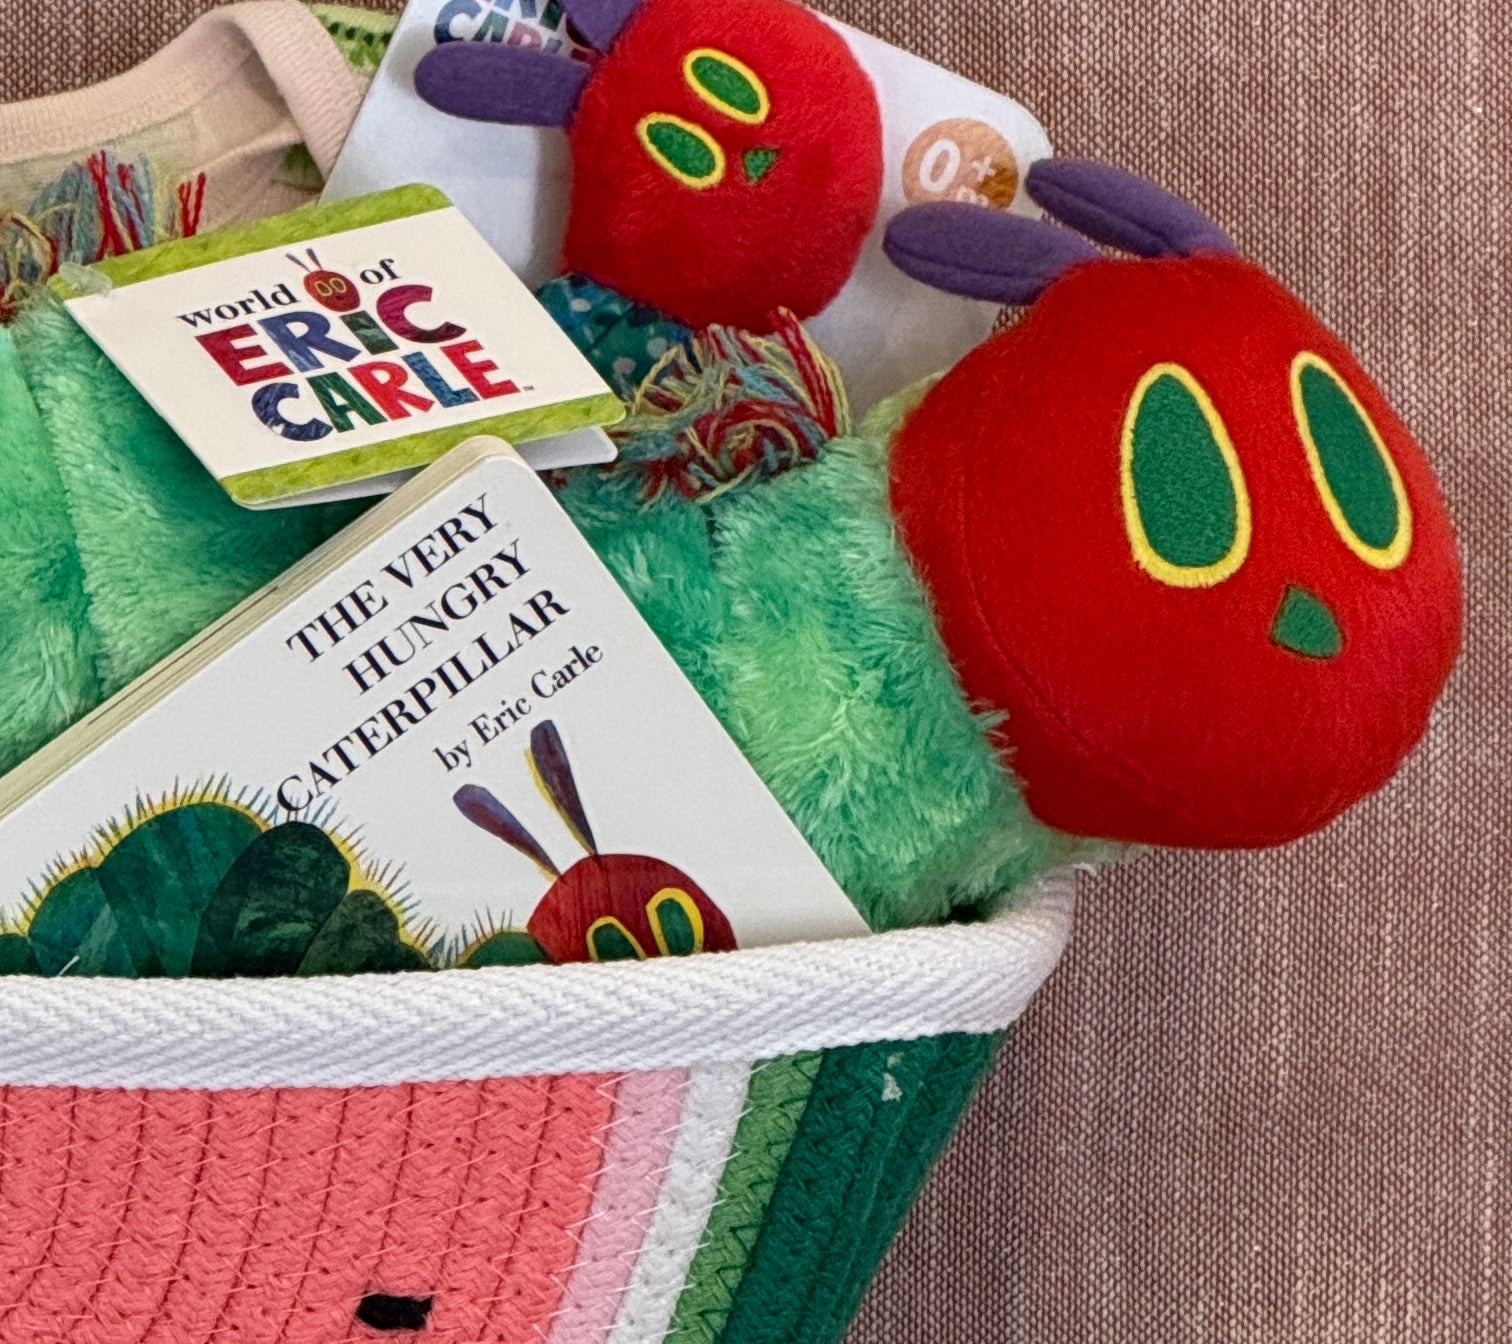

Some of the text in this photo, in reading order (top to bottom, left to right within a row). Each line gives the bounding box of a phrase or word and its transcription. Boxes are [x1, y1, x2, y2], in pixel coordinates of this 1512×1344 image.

[178, 259, 402, 328] world of
[195, 283, 466, 387] ERIC
[251, 338, 521, 442] CARLE
[285, 492, 498, 663] THE VERY
[342, 538, 531, 695] HUNGRY
[276, 588, 571, 813] CATERPILLAR
[432, 642, 604, 773] by Eric Carle
